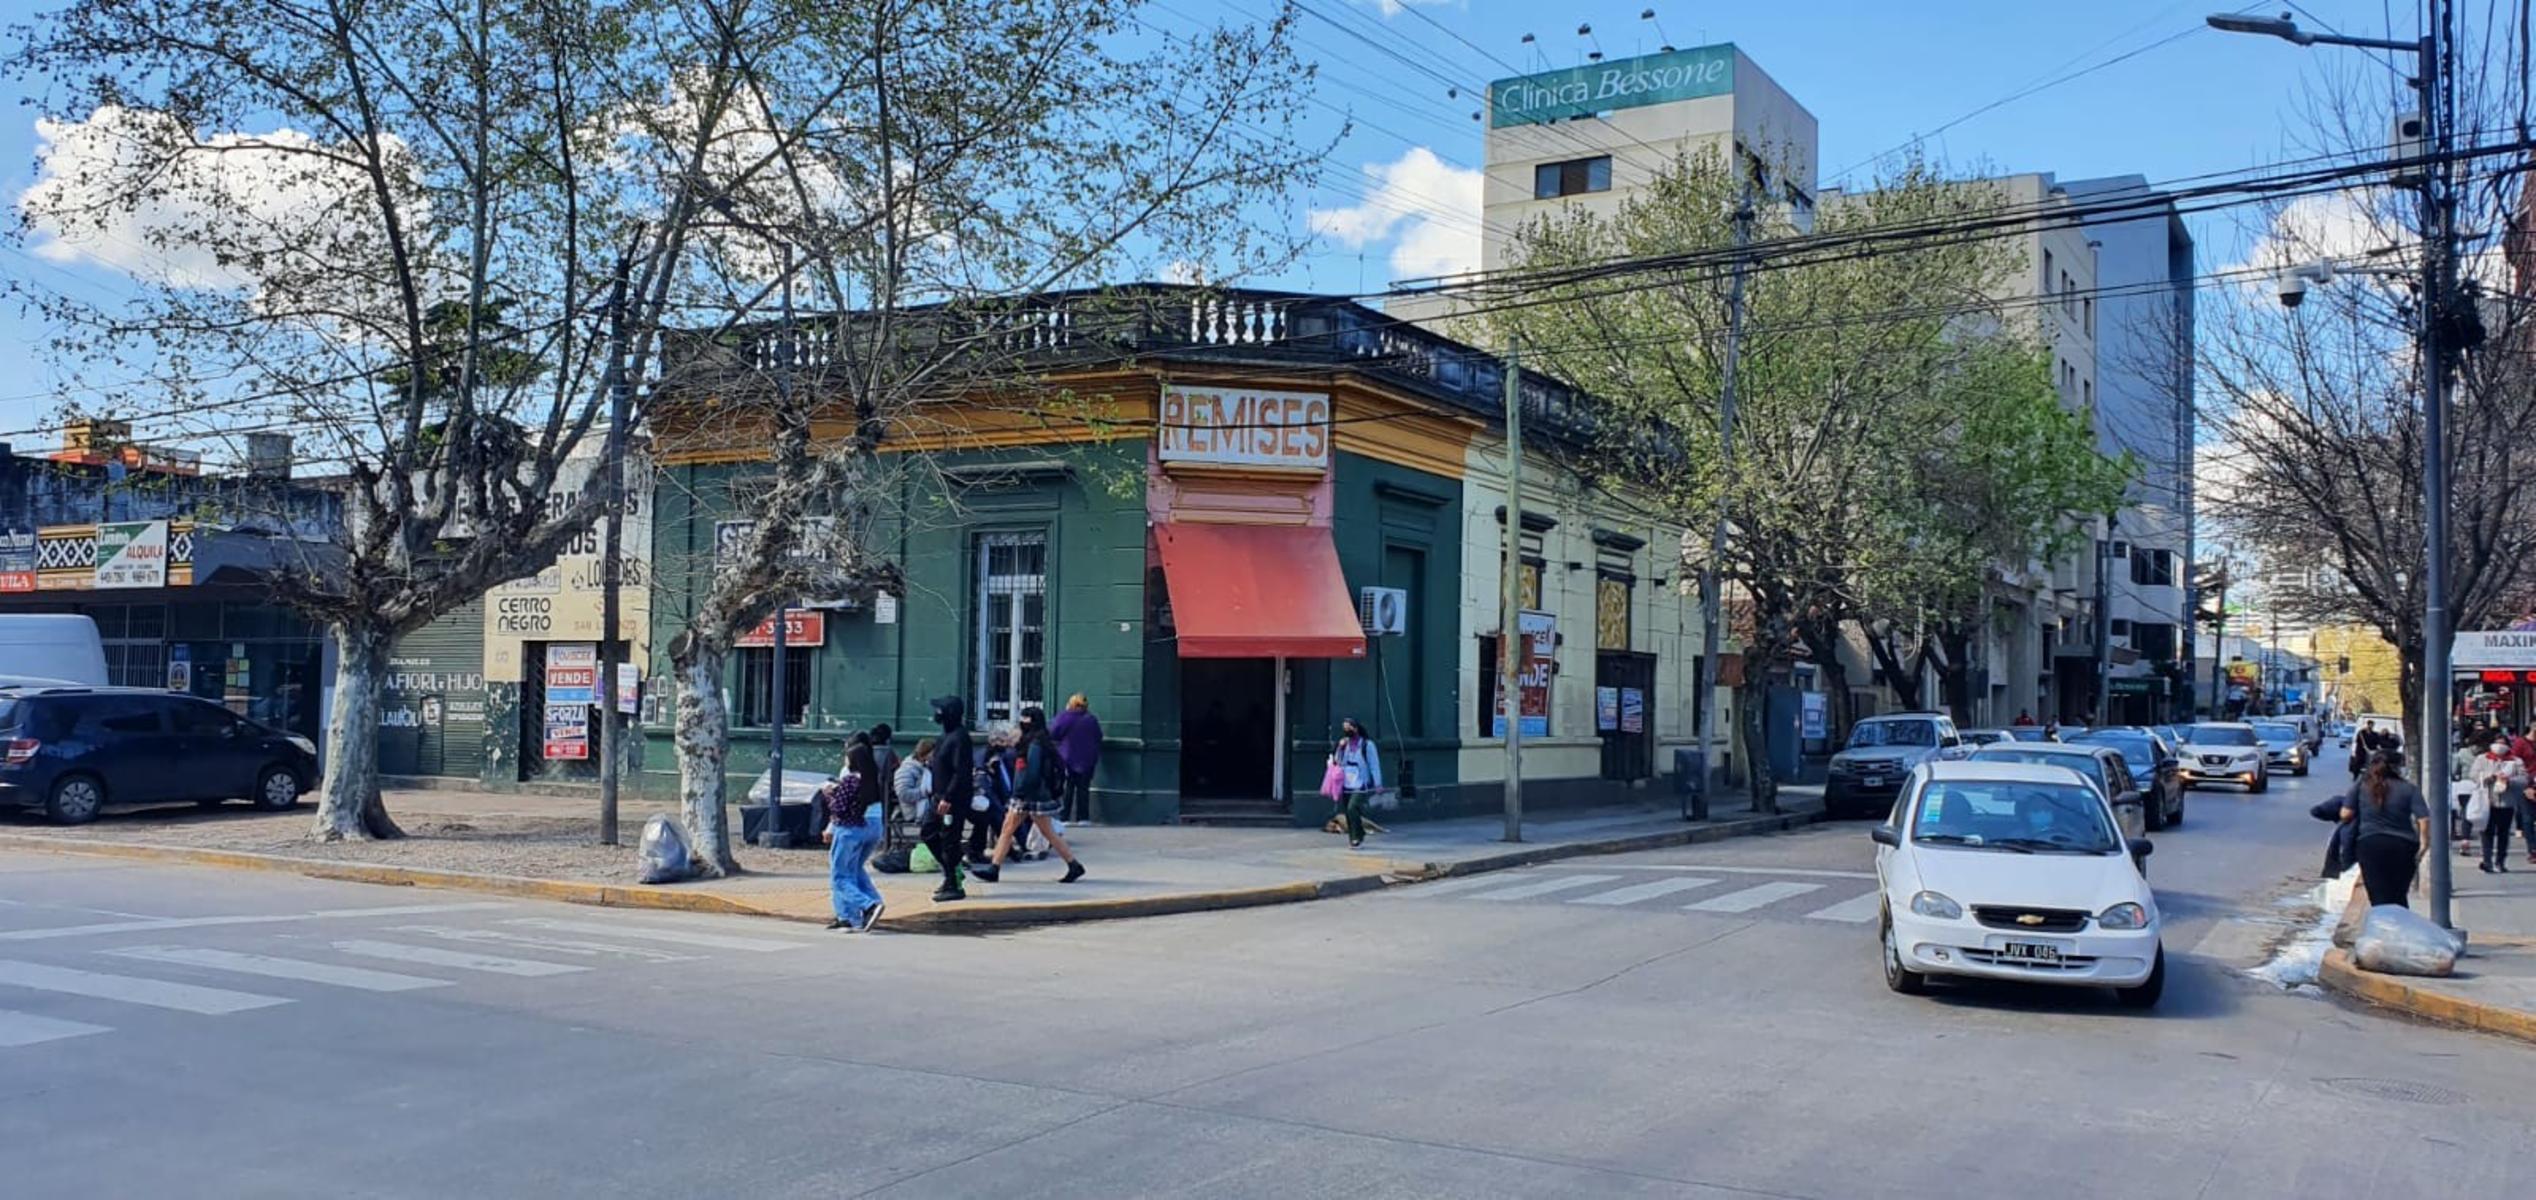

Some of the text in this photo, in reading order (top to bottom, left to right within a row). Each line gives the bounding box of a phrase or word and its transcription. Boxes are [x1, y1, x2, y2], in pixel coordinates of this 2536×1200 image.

[1594, 58, 1725, 100] Bessone
[1163, 393, 1326, 458] REMISES
[126, 545, 164, 559] ALQUILA
[499, 597, 551, 614] CERRO
[499, 615, 551, 632] NEGRO
[550, 671, 591, 684] VENDE
